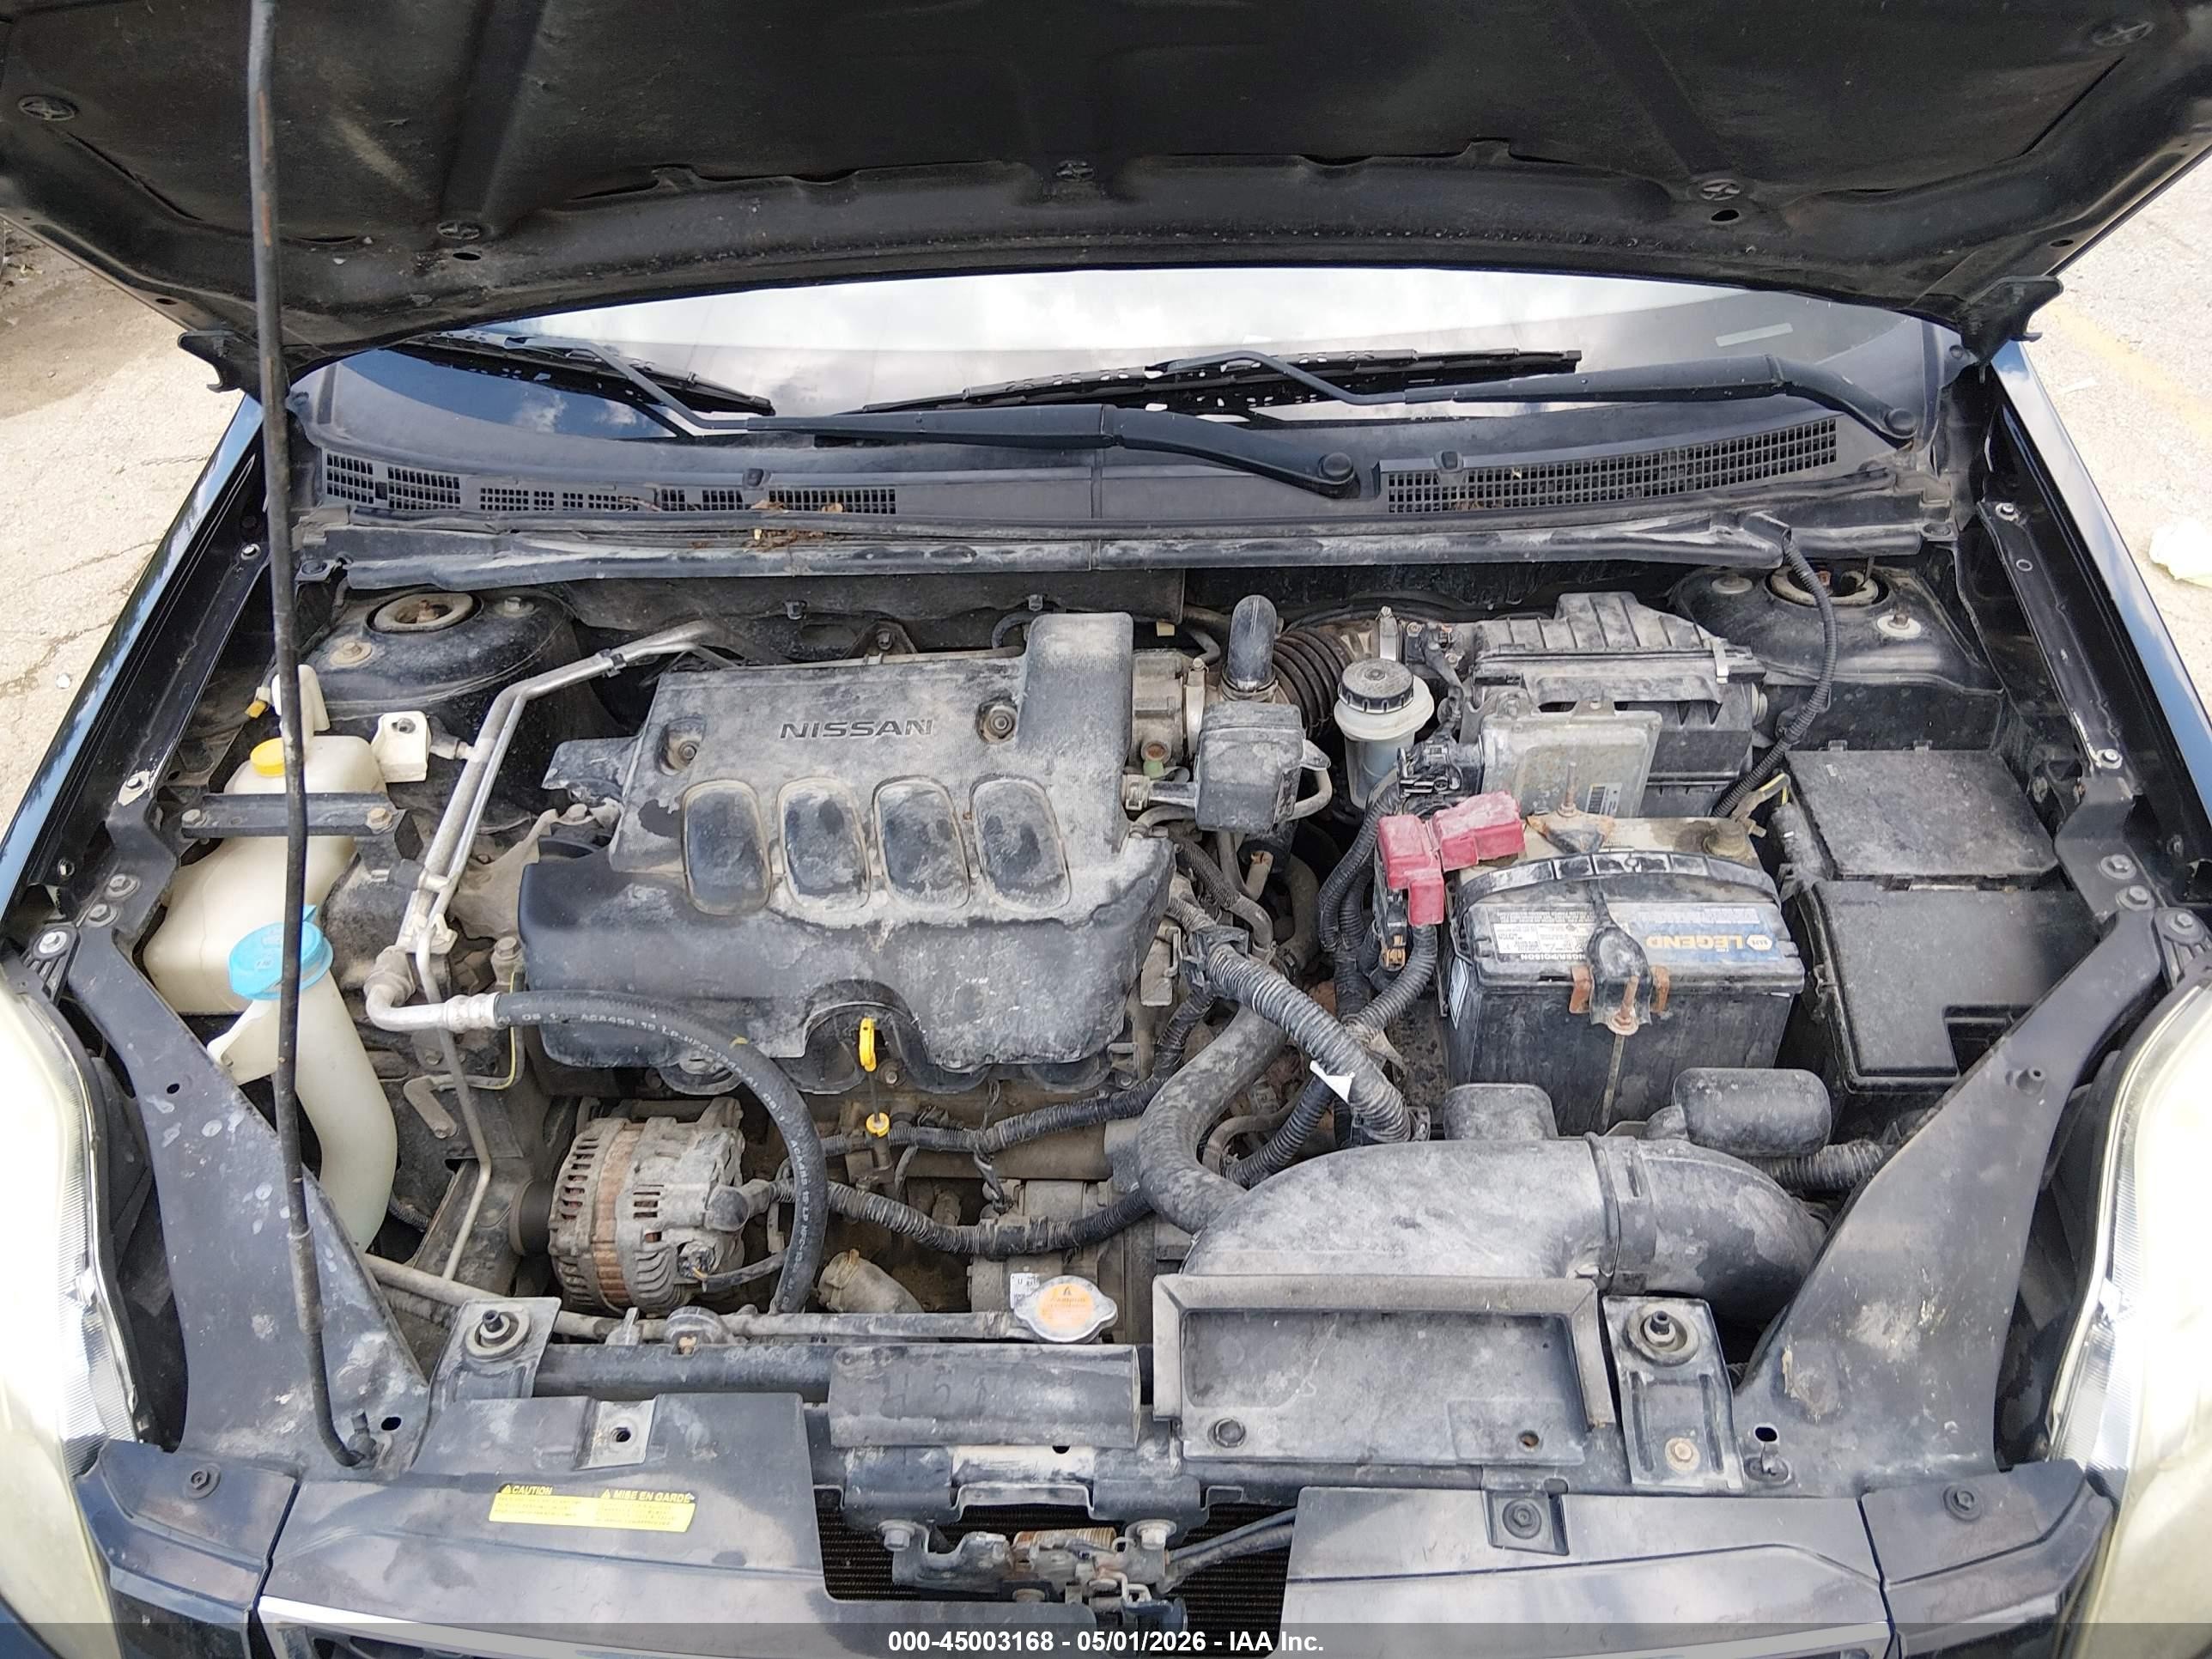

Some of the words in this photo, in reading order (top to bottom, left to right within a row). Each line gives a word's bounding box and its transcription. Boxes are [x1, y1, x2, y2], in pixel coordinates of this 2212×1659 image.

[780, 720, 933, 738] NISSAN
[1645, 934, 1744, 951] LEGEND
[512, 1485, 553, 1496] CAUTION
[612, 1489, 638, 1500] MISE
[639, 1491, 654, 1501] EN
[654, 1492, 692, 1504] GARDE
